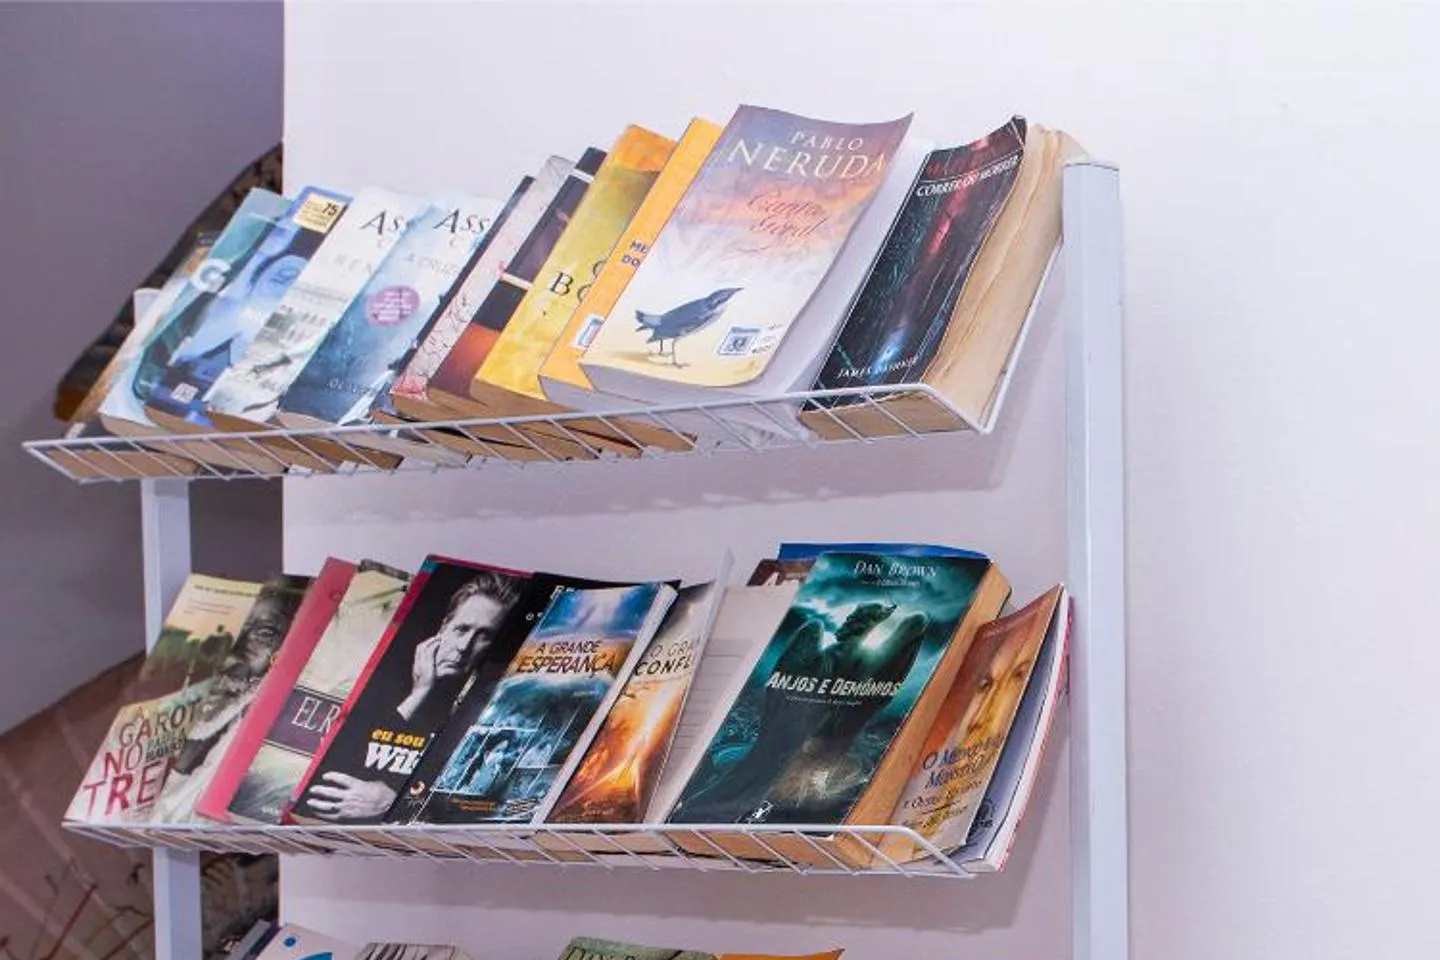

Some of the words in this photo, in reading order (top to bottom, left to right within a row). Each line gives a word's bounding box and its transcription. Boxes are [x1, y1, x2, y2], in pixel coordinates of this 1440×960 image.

[790, 130, 864, 151] PABLO
[727, 138, 886, 179] NERUDA
[854, 560, 884, 575] DAN
[888, 562, 941, 577] BROWN
[516, 655, 614, 679] ESPERANÇA
[765, 671, 818, 692] ANJOS
[818, 679, 832, 694] E
[393, 732, 425, 748] sou
